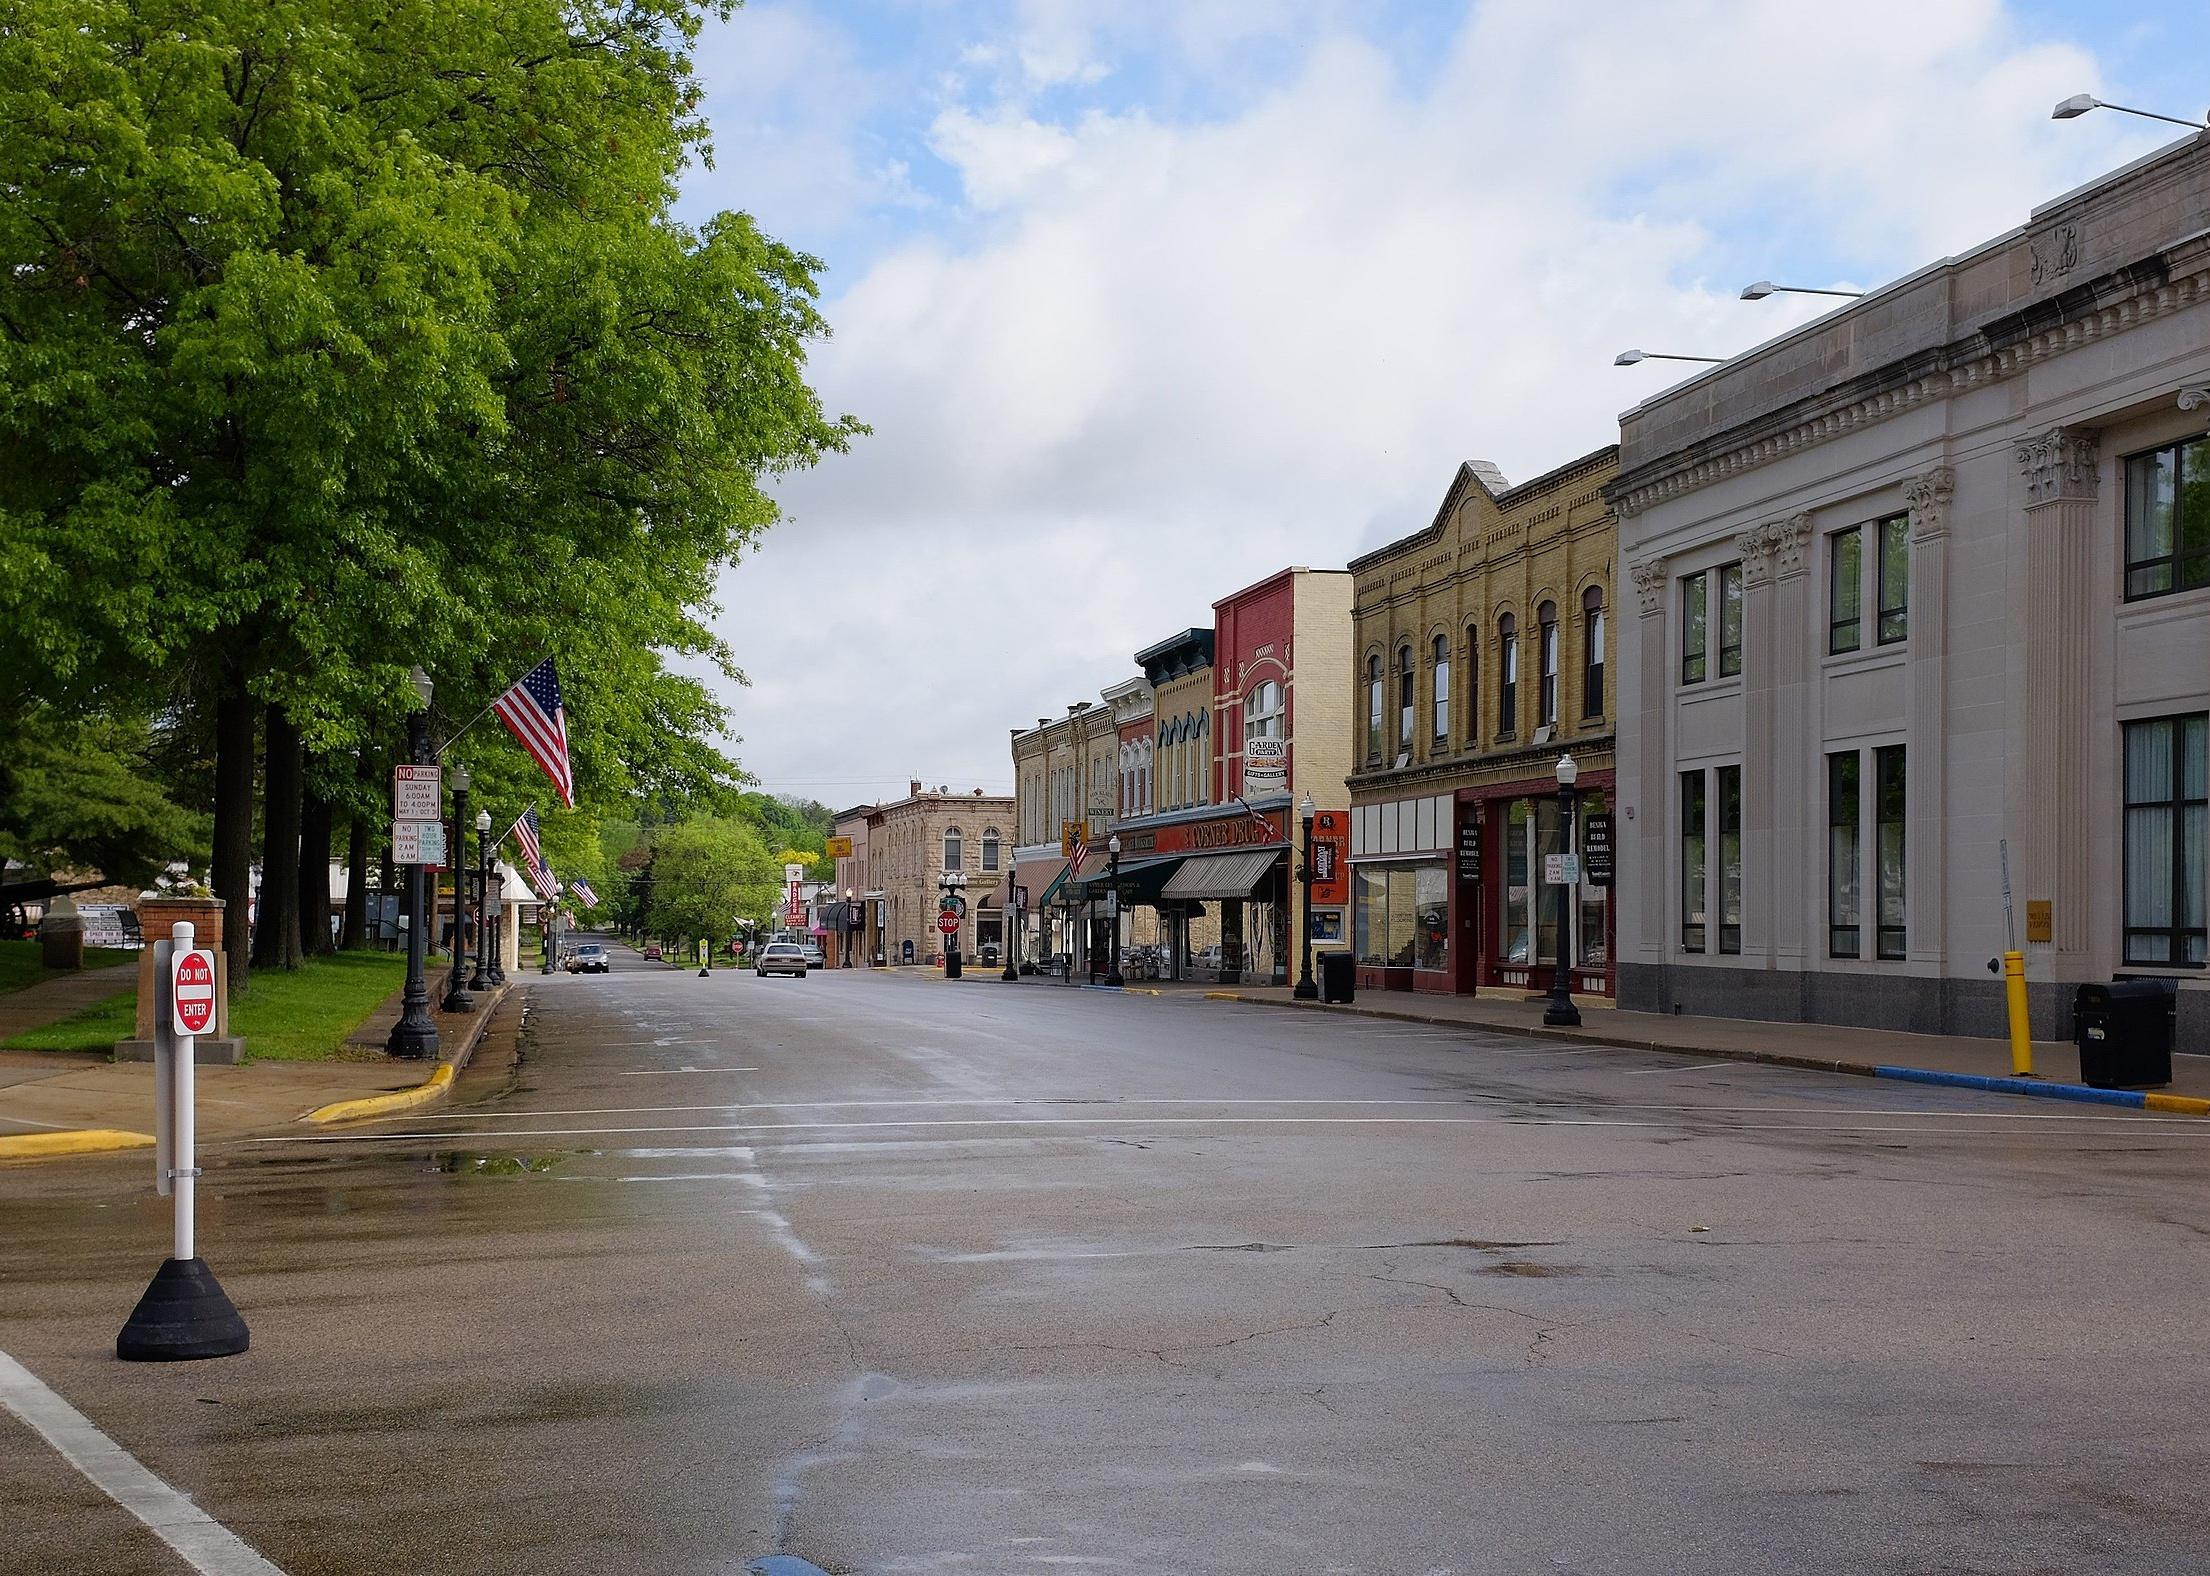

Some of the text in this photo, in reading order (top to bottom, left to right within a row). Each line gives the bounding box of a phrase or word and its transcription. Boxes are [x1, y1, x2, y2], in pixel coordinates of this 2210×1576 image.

[1249, 741, 1283, 756] GARDEN
[398, 768, 438, 779] NO PARKING
[1192, 823, 1229, 848] CORNER
[980, 879, 998, 887] Gallery
[938, 918, 959, 927] STOP
[180, 968, 208, 981] DO NOT
[184, 1003, 207, 1017] ENTER
